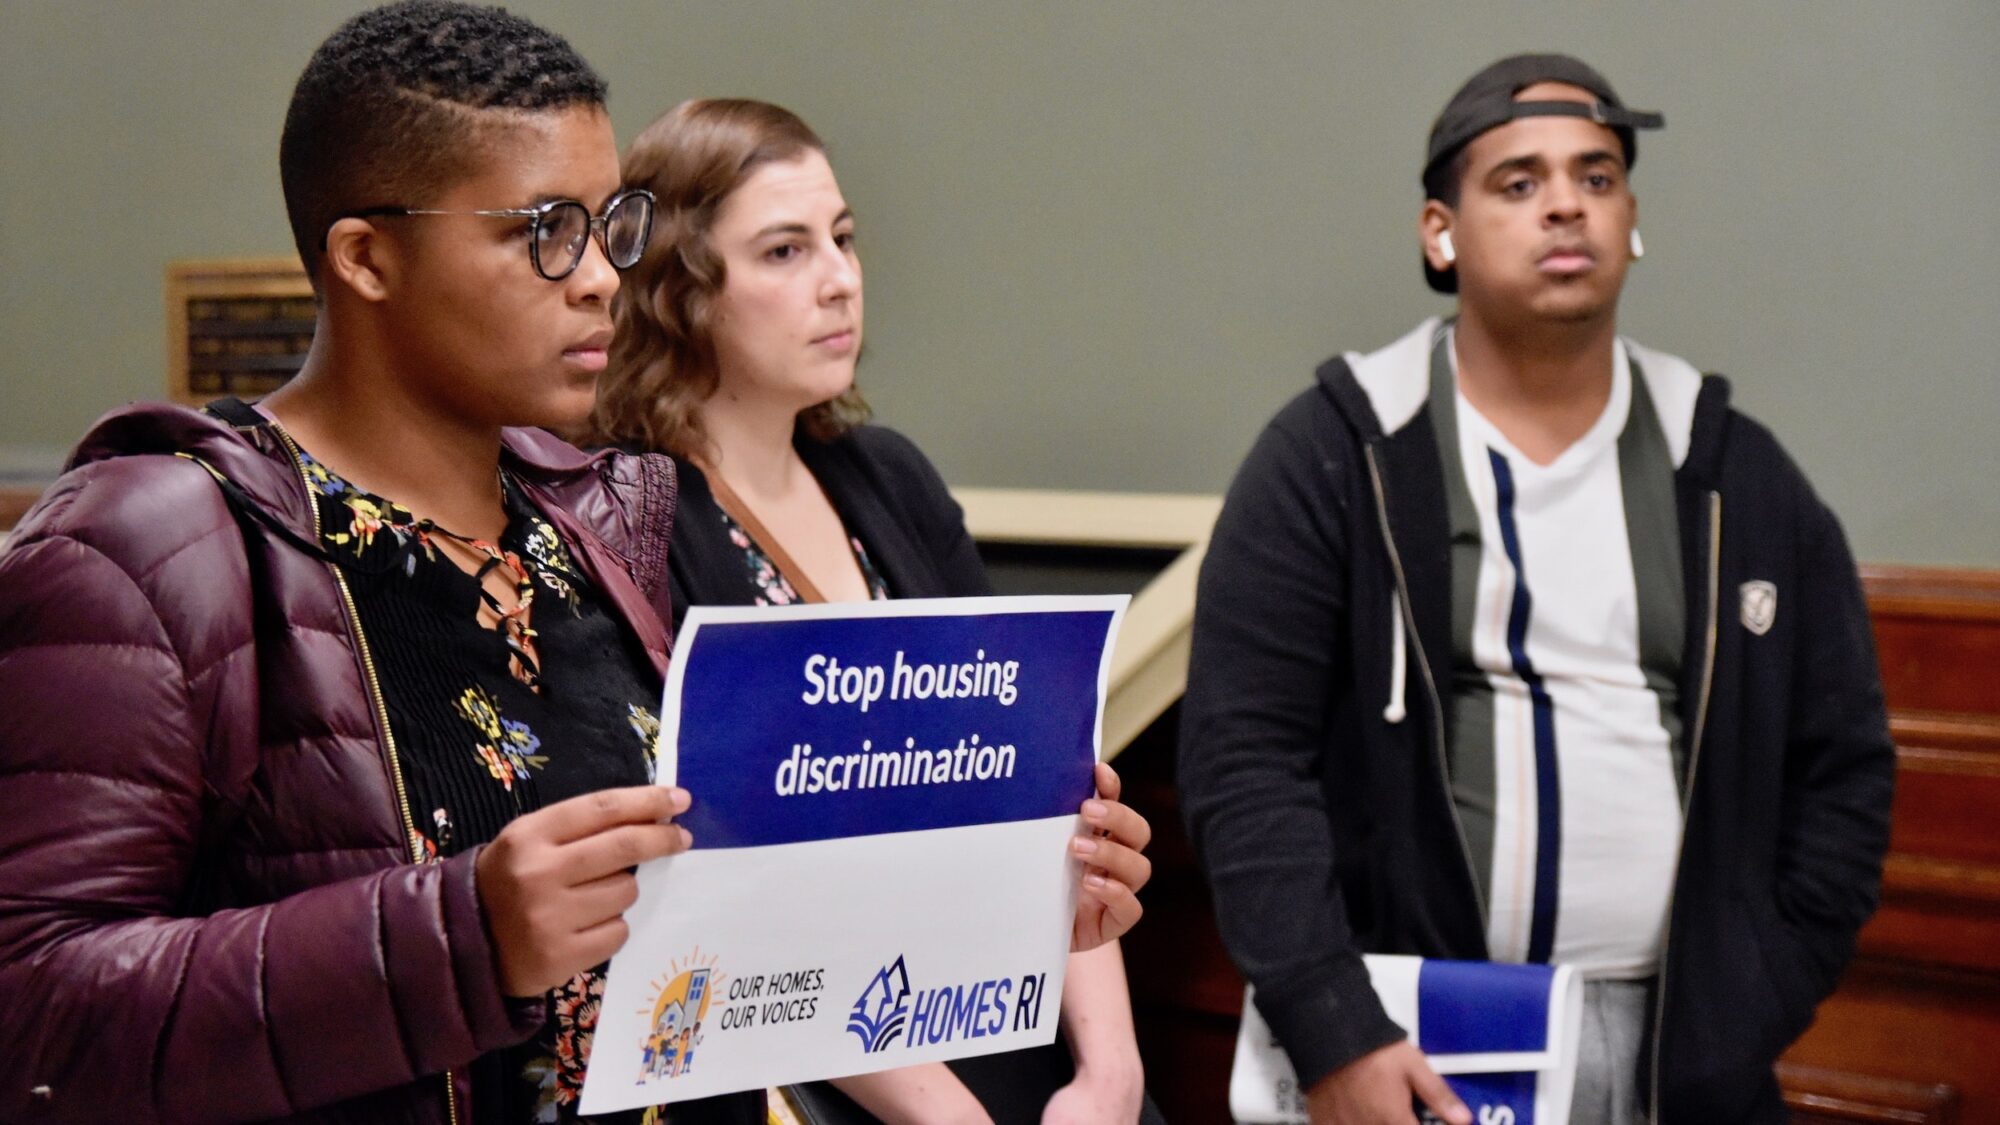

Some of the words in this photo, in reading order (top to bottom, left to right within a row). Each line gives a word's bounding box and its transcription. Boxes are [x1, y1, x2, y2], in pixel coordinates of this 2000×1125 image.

[802, 653, 885, 713] Stop
[891, 648, 1020, 706] housing
[775, 733, 1016, 797] discrimination
[720, 1004, 757, 1031] OUR
[761, 996, 819, 1026] VOICES
[728, 975, 765, 1001] OUR
[767, 968, 825, 996] HOMES,
[907, 977, 1012, 1049] HOMES
[1012, 972, 1047, 1032] RI
